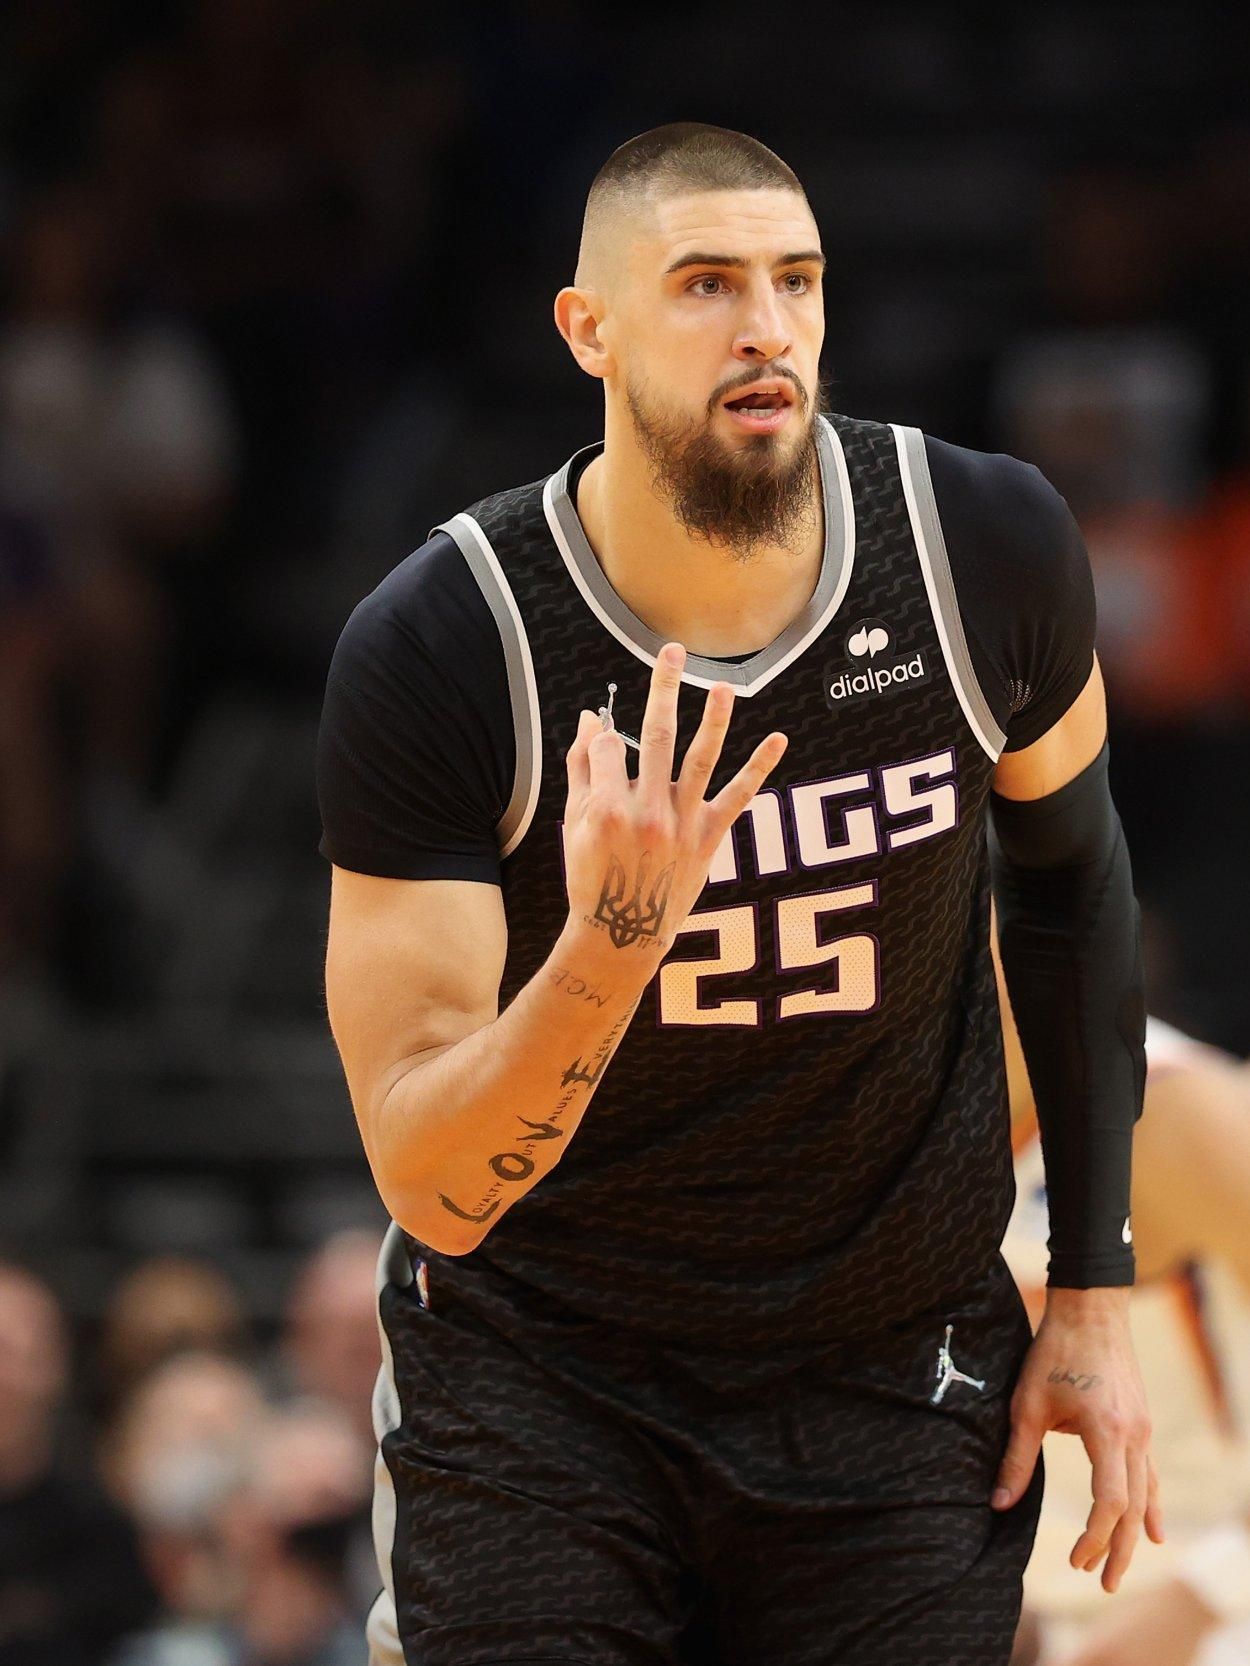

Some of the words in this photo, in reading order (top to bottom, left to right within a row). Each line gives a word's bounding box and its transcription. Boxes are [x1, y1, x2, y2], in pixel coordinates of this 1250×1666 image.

[829, 653, 925, 700] dialpad
[558, 747, 958, 888] NGS
[656, 880, 881, 1028] 25
